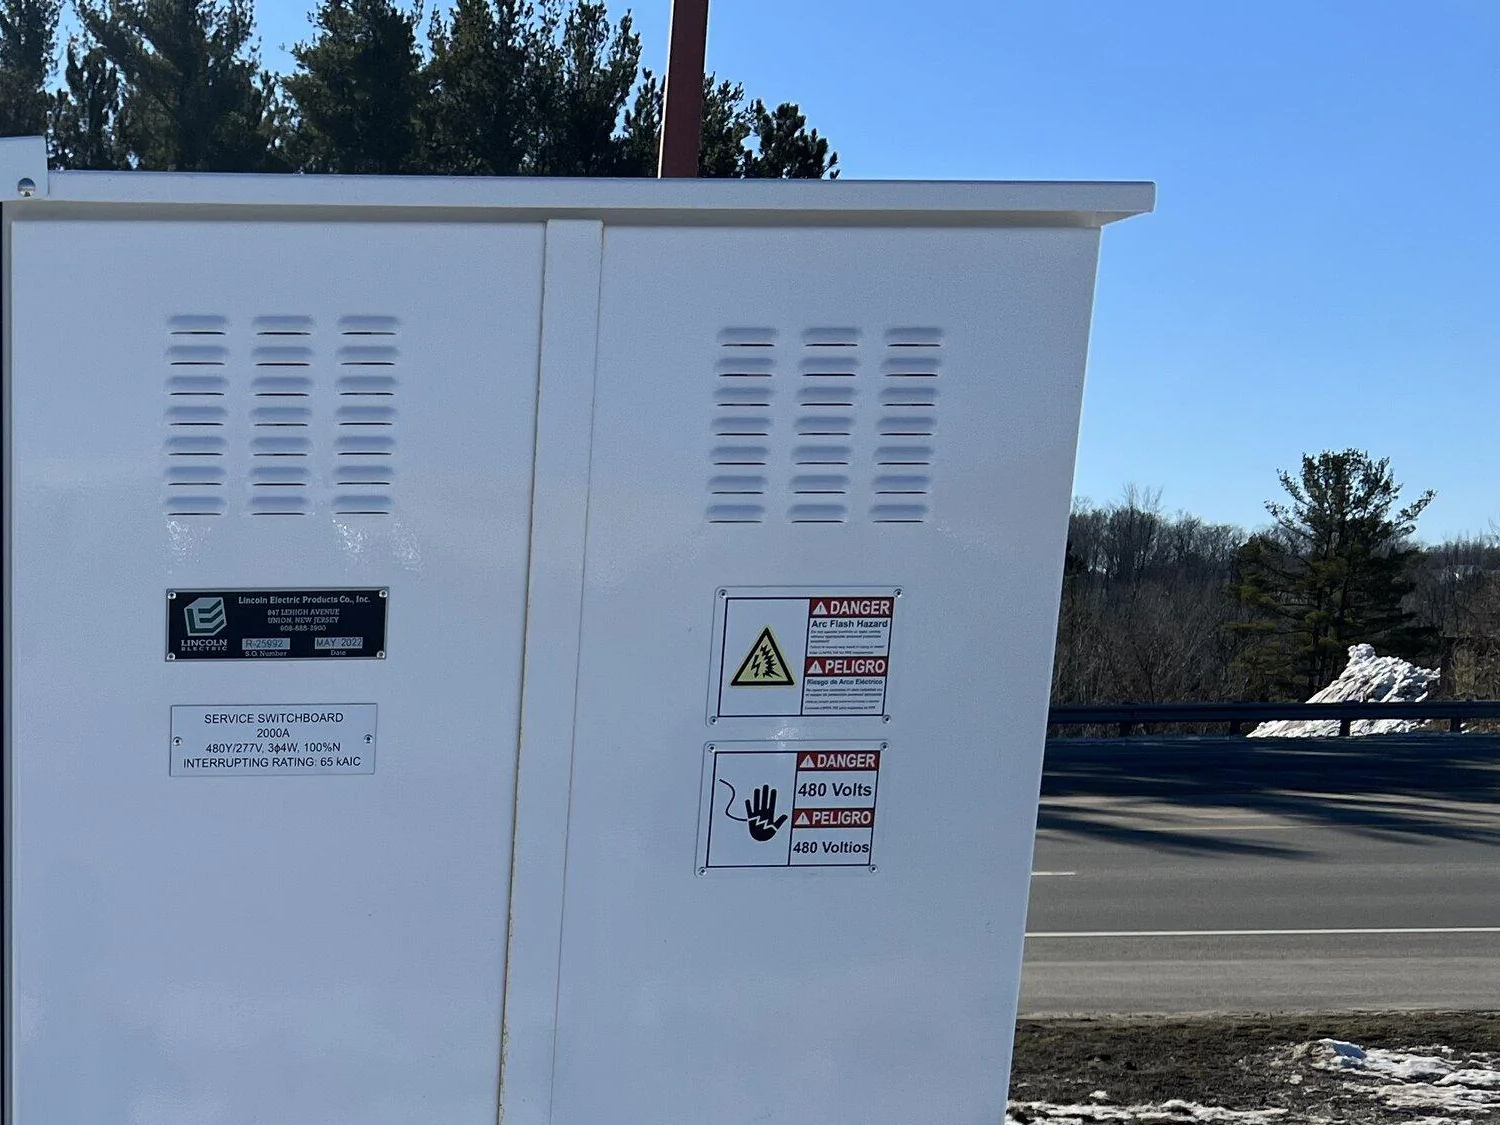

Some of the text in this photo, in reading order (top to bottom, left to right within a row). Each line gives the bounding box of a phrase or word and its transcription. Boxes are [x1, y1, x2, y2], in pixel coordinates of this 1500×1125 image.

[238, 596, 268, 604] Lincoln
[269, 596, 300, 604] Electric
[302, 596, 338, 604] Products
[355, 595, 371, 603] Inc.
[280, 608, 309, 616] LEHIGH
[309, 608, 340, 616] AVENUE
[830, 600, 890, 616] DANGER
[295, 616, 313, 624] NEW
[313, 616, 340, 624] JERSEY
[811, 619, 888, 628] Arc Flash Hazard
[180, 639, 227, 647] LINCOLN
[316, 637, 363, 648] MAY 2022
[825, 659, 886, 674] PELIGRO
[806, 678, 829, 686] Riesgo
[203, 713, 344, 724] SERVICE SWITCHBOARD
[256, 728, 290, 738] 2000A
[206, 743, 265, 754] 480Y/277V,
[304, 742, 341, 752] 100%N
[183, 756, 361, 768] INTERRUPTING RATING: 65 kAIC
[817, 754, 876, 768] DANGER
[797, 782, 872, 797] 480 Volts
[812, 811, 871, 825] PELIGRO
[793, 841, 870, 854] 480 Voltios
